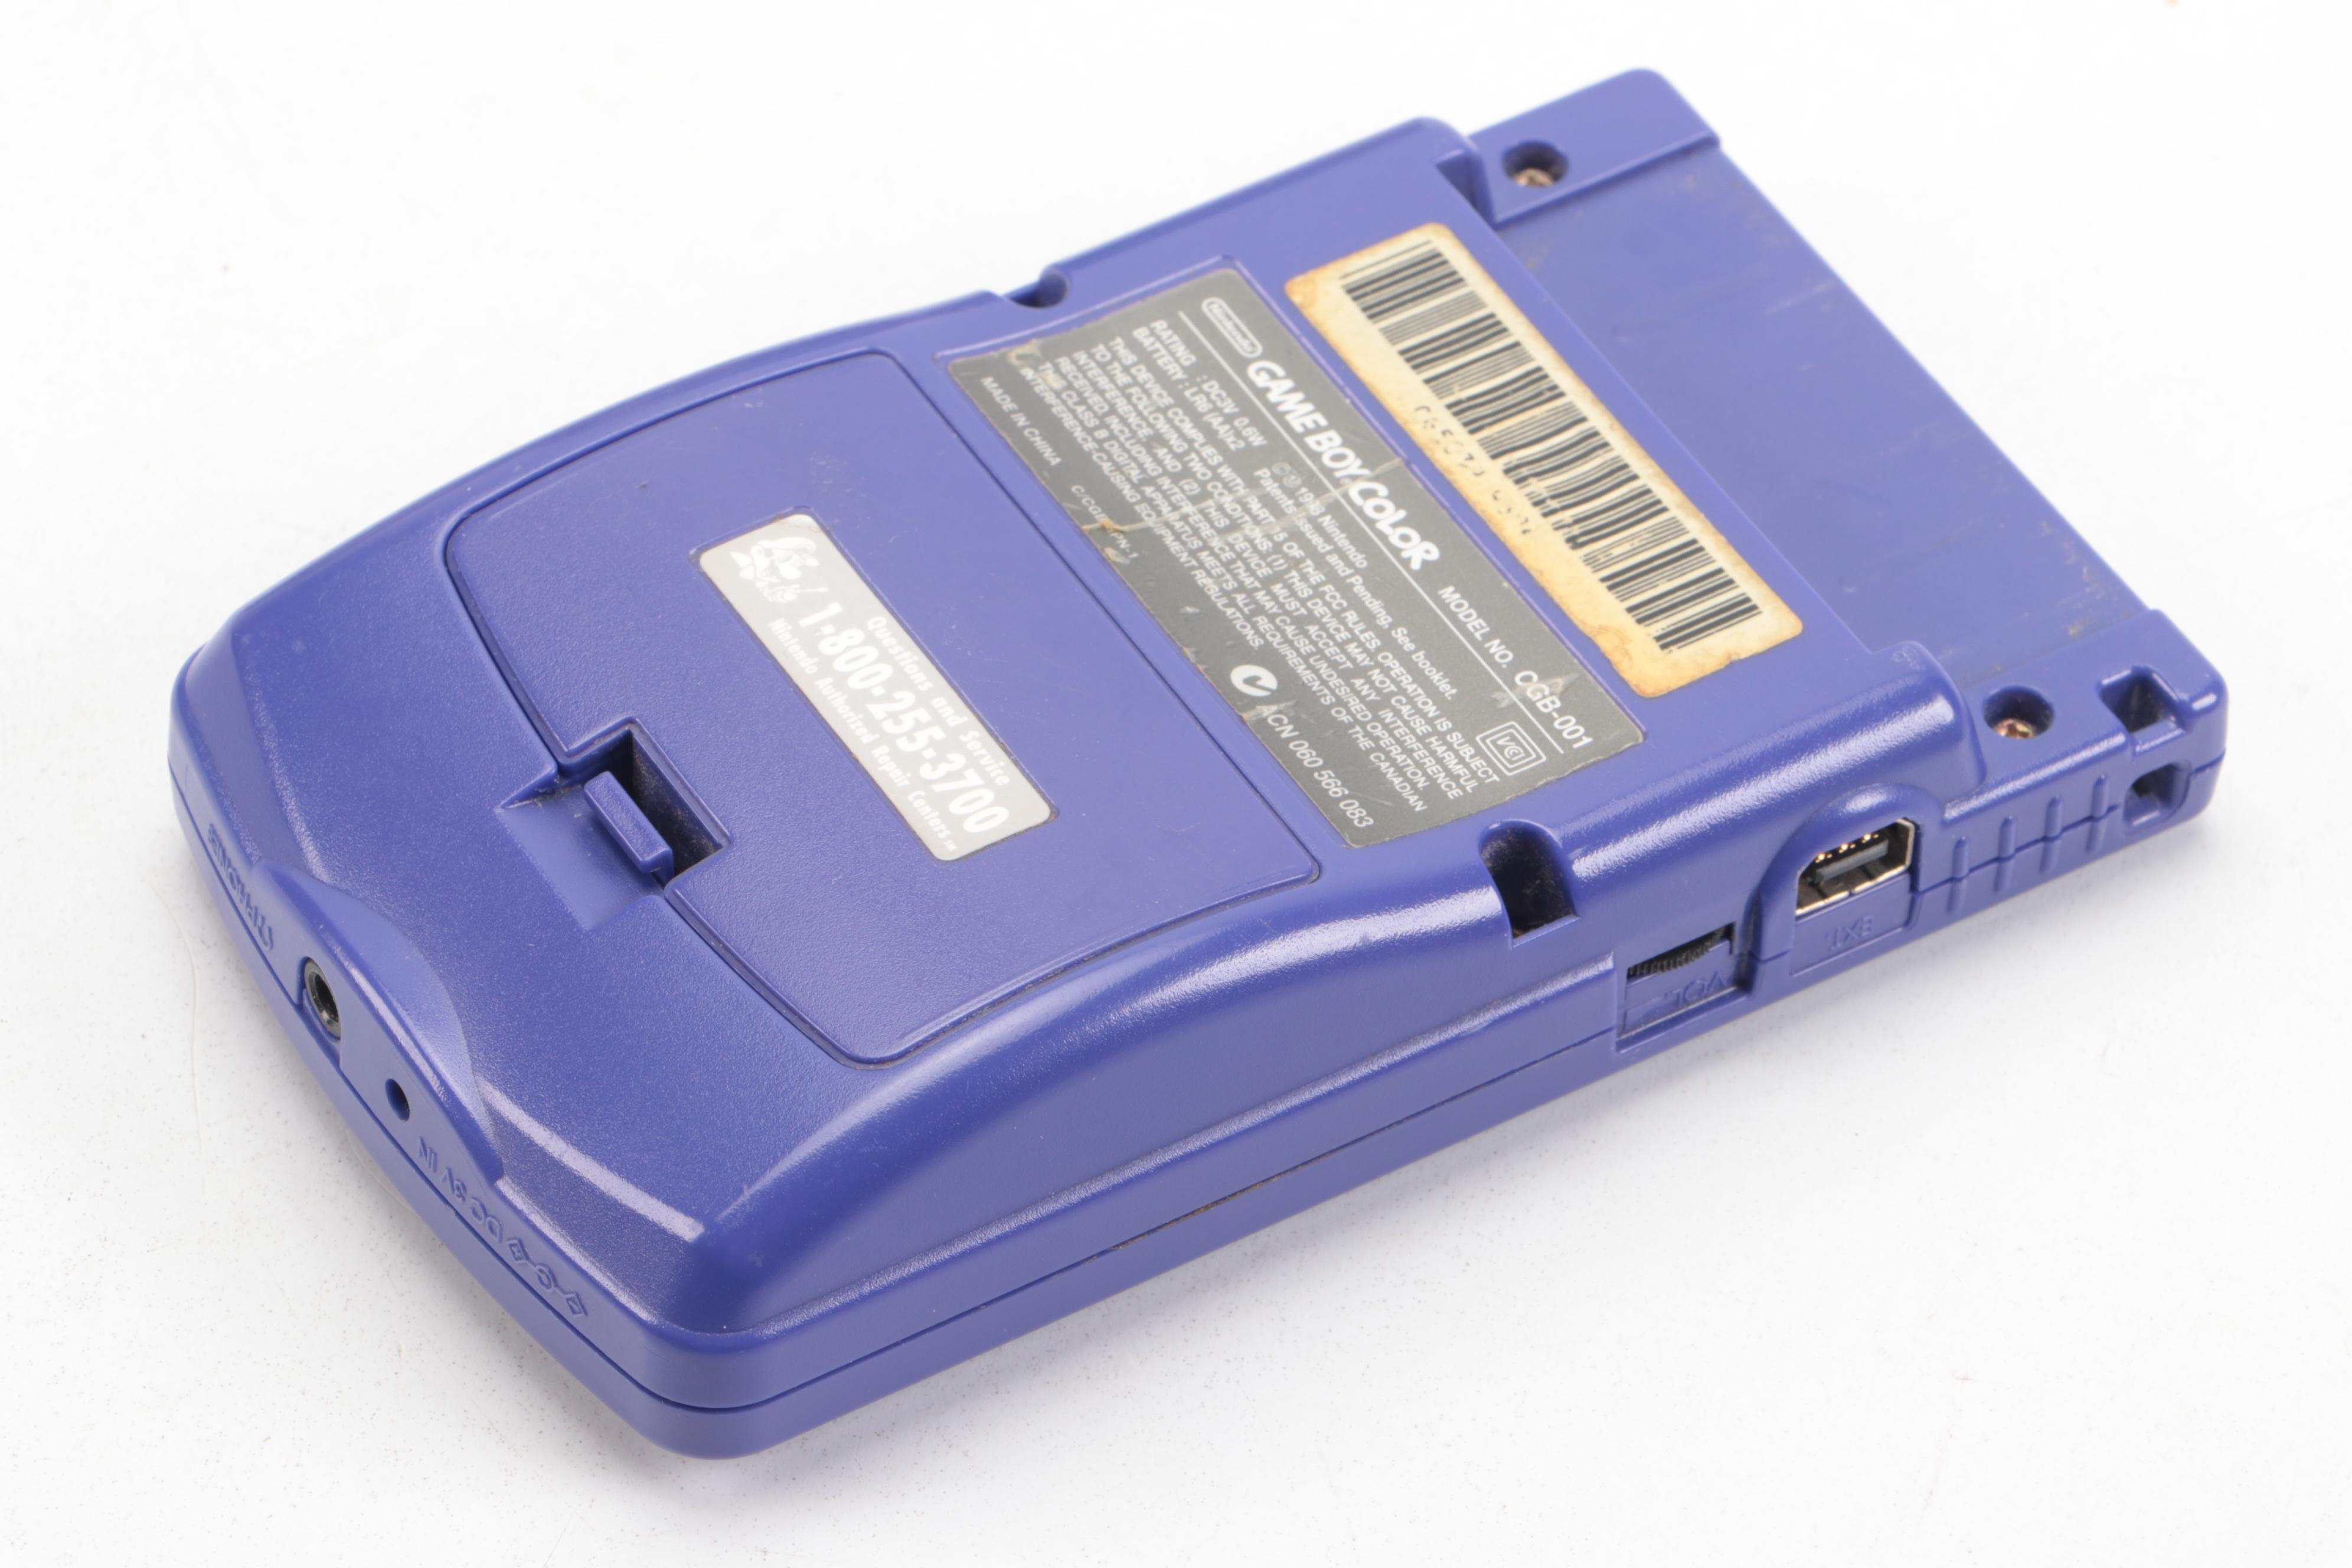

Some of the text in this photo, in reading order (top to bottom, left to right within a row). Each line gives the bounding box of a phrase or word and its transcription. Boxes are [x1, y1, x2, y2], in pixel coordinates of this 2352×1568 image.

[981, 377, 1061, 466] MADE IN CHINA
[1132, 326, 1187, 380] BATTERY
[1184, 387, 1213, 413] LR6
[1149, 319, 1197, 367] RATING
[1201, 380, 1239, 414] DC3V
[1233, 417, 1268, 446] 0.6W
[1247, 360, 1328, 433] GAME
[1304, 430, 1372, 484] BOY
[1020, 367, 1141, 503] INTERFERENCE-CAUSING
[1190, 569, 1265, 650] REGULATIONS.
[1091, 343, 1112, 362] TO
[1106, 361, 1133, 387] THE
[1126, 386, 1188, 453] FOLLOWING
[1184, 452, 1213, 481] TWO
[1266, 554, 1288, 571] (1)
[1284, 569, 1314, 598] THIS
[1306, 598, 1352, 642] DEVICE
[1344, 642, 1374, 666] MAY
[1367, 668, 1398, 693] NOT
[1390, 695, 1433, 736] CAUSE
[1425, 736, 1479, 793] HARMFUL
[1109, 337, 1138, 365] THIS
[1130, 364, 1174, 408] DEVICE
[1167, 407, 1223, 466] COMPLIES
[1217, 464, 1250, 496] WITH
[1243, 495, 1277, 525] PART
[1282, 541, 1305, 558] OF
[1299, 558, 1327, 585] THE
[1318, 584, 1348, 610] FCC
[1341, 610, 1381, 652] RULES.
[1377, 652, 1440, 718] OPERATION
[1433, 717, 1452, 731] IS
[1446, 731, 1500, 783] SUBJECT
[1253, 468, 1304, 515] Patents
[1325, 553, 1354, 577] and
[1345, 574, 1393, 629] Pending,
[1391, 626, 1416, 652] See
[1411, 650, 1458, 700] booklet.
[1317, 514, 1368, 569] Nintendo
[1061, 390, 1100, 428] CLASS
[1093, 429, 1109, 439] B
[1103, 440, 1145, 484] DIGITAL
[1197, 550, 1238, 590] MEETS
[1231, 593, 1256, 615] ALL
[1252, 615, 1336, 705] REQUIREMENTS
[1331, 707, 1354, 723] OF
[1348, 724, 1376, 751] THE
[1370, 752, 1427, 812] CANADIAN
[1105, 415, 1163, 476] INCLUDING
[1157, 476, 1236, 562] INTERFERENCE
[1230, 560, 1262, 589] THAT
[1253, 590, 1282, 613] MAY
[1275, 616, 1317, 655] CAUSE
[1309, 655, 1373, 721] UNDESIRED
[1366, 722, 1430, 790] OPERATION.
[1154, 447, 1182, 472] AND
[1178, 478, 1201, 495] (2)
[1197, 499, 1230, 528] THIS
[1225, 532, 1273, 578] DEVICE
[1270, 583, 1308, 616] MUST
[1304, 625, 1354, 669] ACCEPT
[1350, 678, 1381, 701] ANY
[1378, 708, 1464, 799] INTERFERENCE
[1438, 586, 1490, 641] MODEL
[1484, 638, 1514, 668] NO.
[1514, 670, 1593, 749] CGB-001
[767, 618, 819, 674] Nintendo
[814, 677, 880, 744] Authorized
[870, 744, 912, 787] Repair
[798, 601, 1010, 833] 1-800-255-3700
[866, 616, 1010, 786] Questions and Service
[1256, 704, 1374, 828] ACN 060 566 083
[471, 1196, 502, 1243] DC
